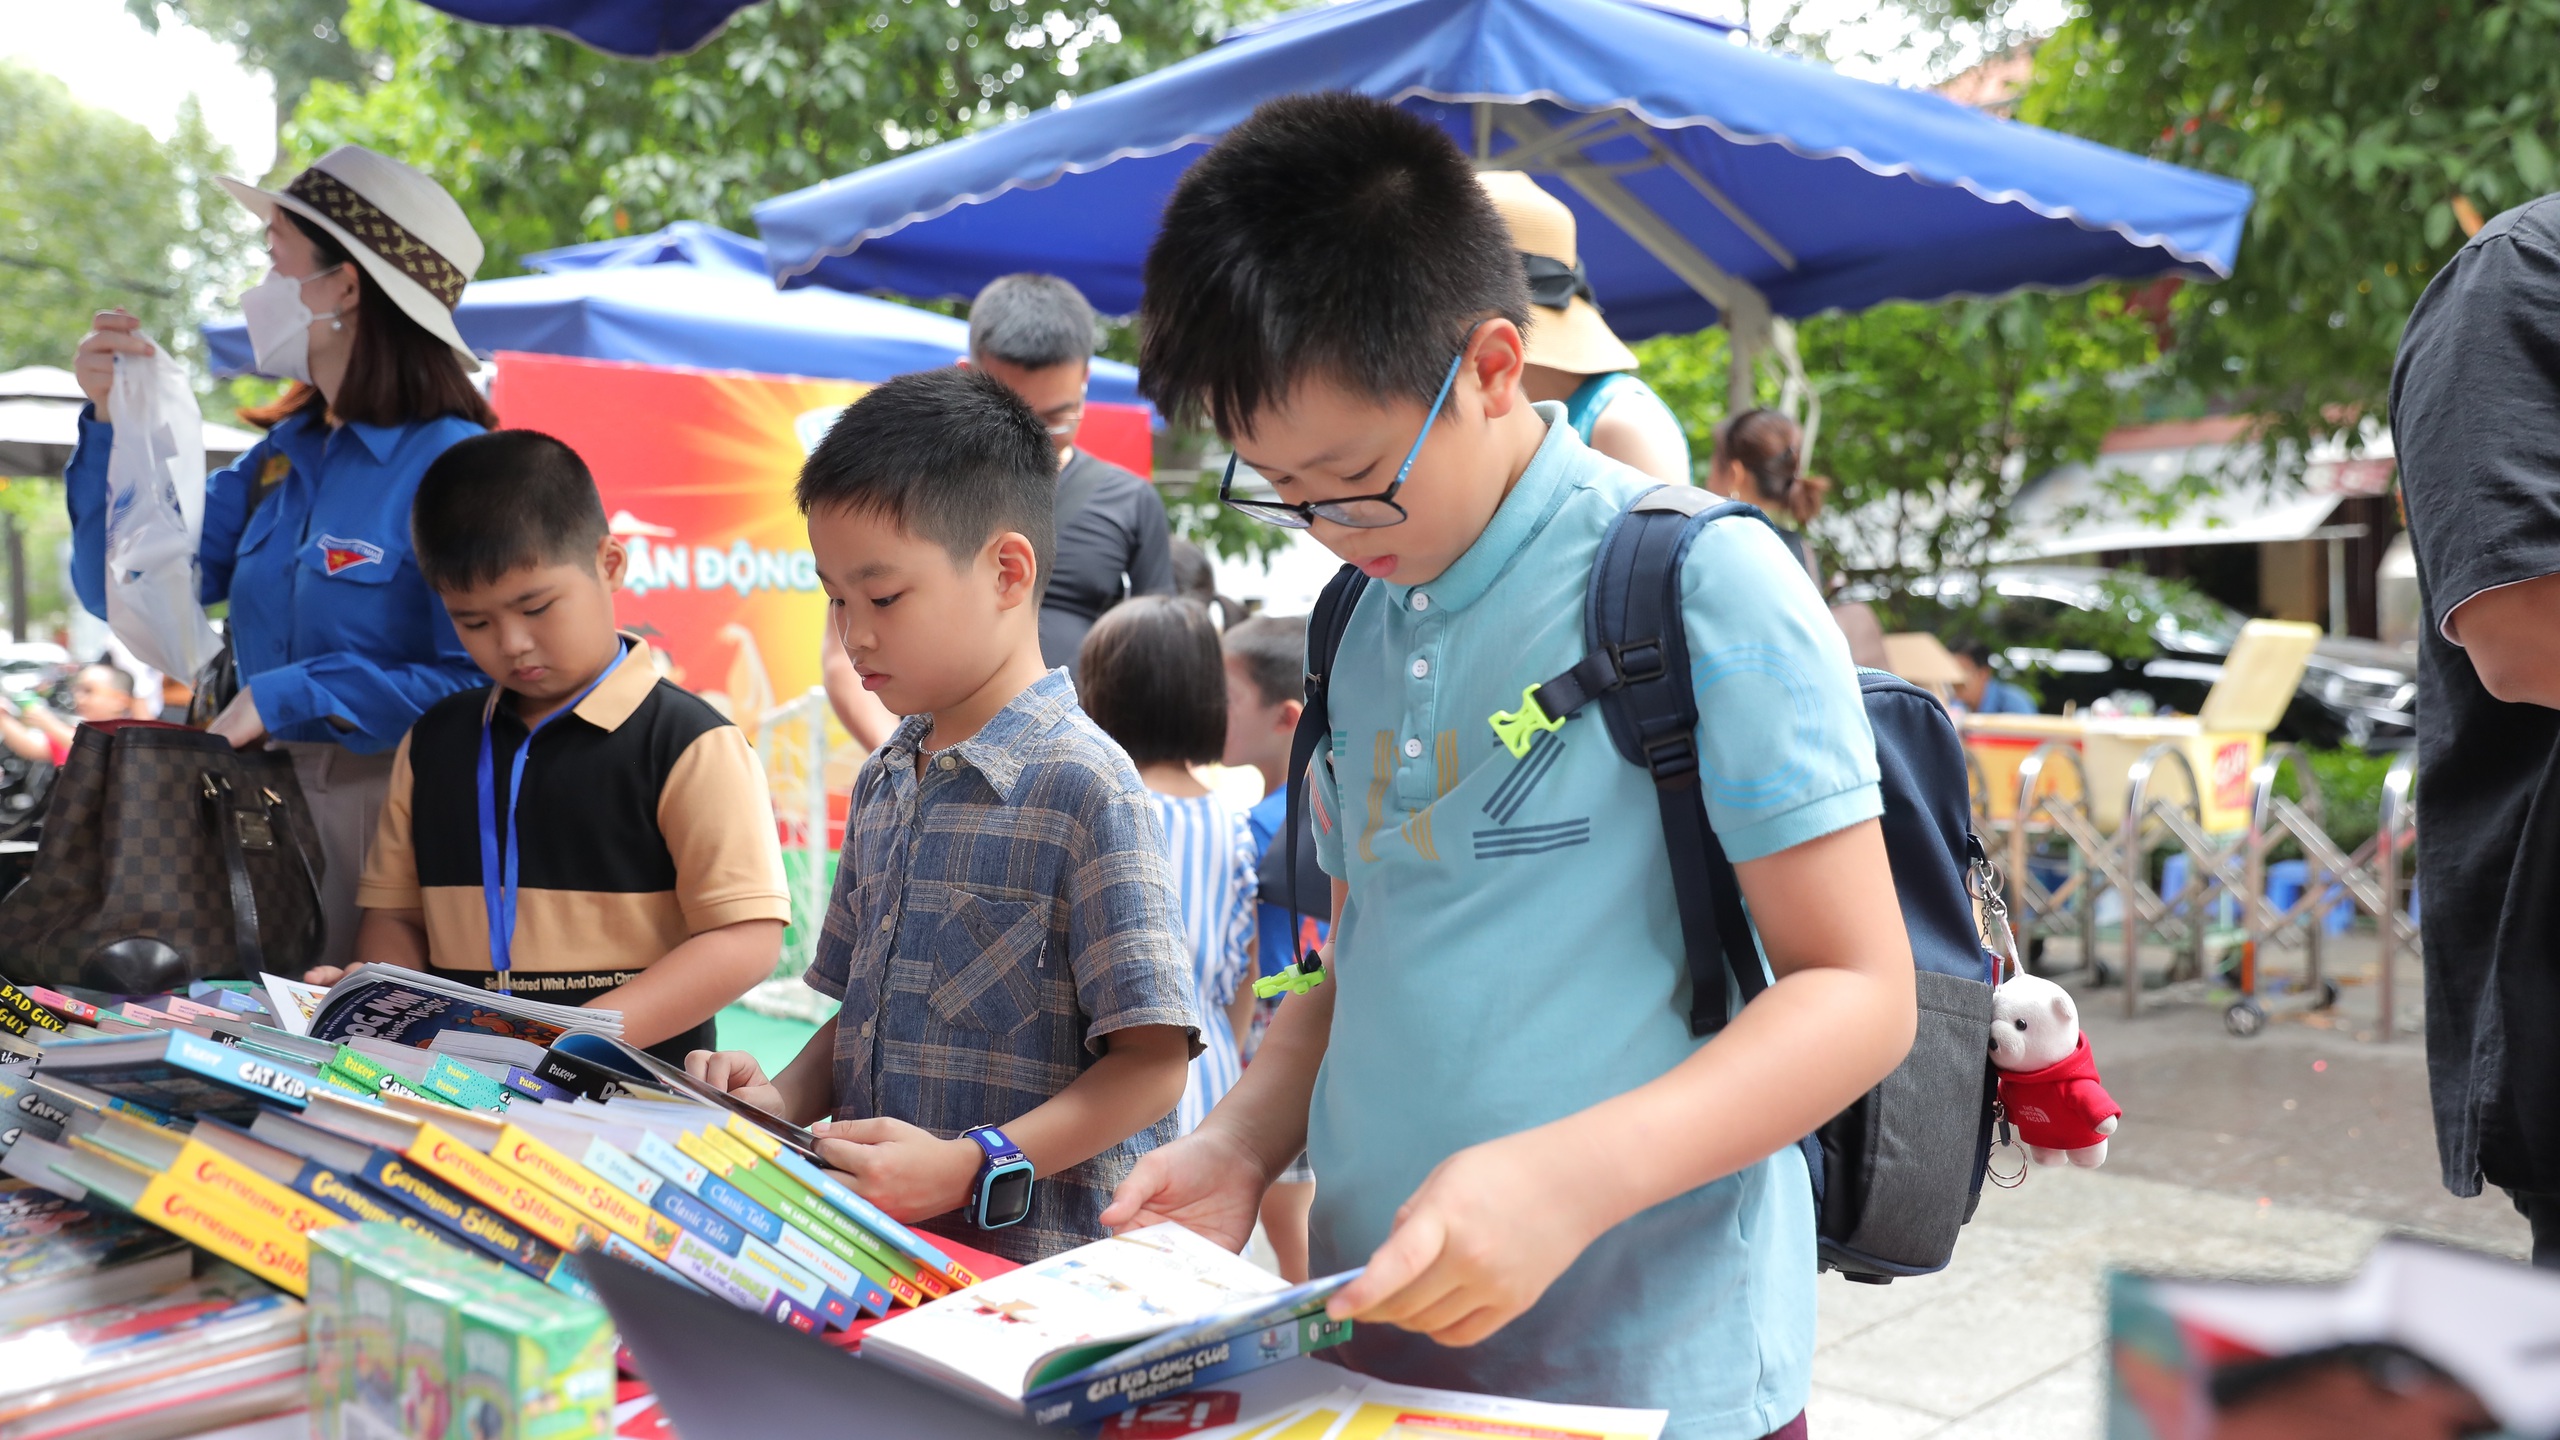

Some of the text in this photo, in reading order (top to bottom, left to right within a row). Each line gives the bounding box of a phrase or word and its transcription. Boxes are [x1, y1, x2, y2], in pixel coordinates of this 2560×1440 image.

[694, 539, 820, 597] ĐỘNG
[0, 984, 31, 1011] BAD
[365, 990, 428, 1016] MAN
[541, 977, 565, 991] Whit
[566, 976, 587, 990] And
[588, 974, 613, 988] Done
[238, 1061, 272, 1090] CAT
[195, 1160, 286, 1218] Geronimo
[380, 1162, 462, 1219] Geronimo
[461, 1206, 519, 1251] Stilton
[433, 1142, 565, 1230] Geronimo Stilton
[513, 1142, 640, 1228] Geronimo Stilton
[710, 1183, 772, 1234] Classic Tales
[804, 1195, 818, 1208] THE
[818, 1204, 835, 1220] LAST
[163, 1193, 256, 1250] Geronimo
[665, 1195, 731, 1246] Classic Tales
[780, 1201, 793, 1215] THE
[792, 1209, 810, 1227] LAST
[1086, 1376, 1118, 1403] CAT
[1194, 1343, 1230, 1369] CLUB
